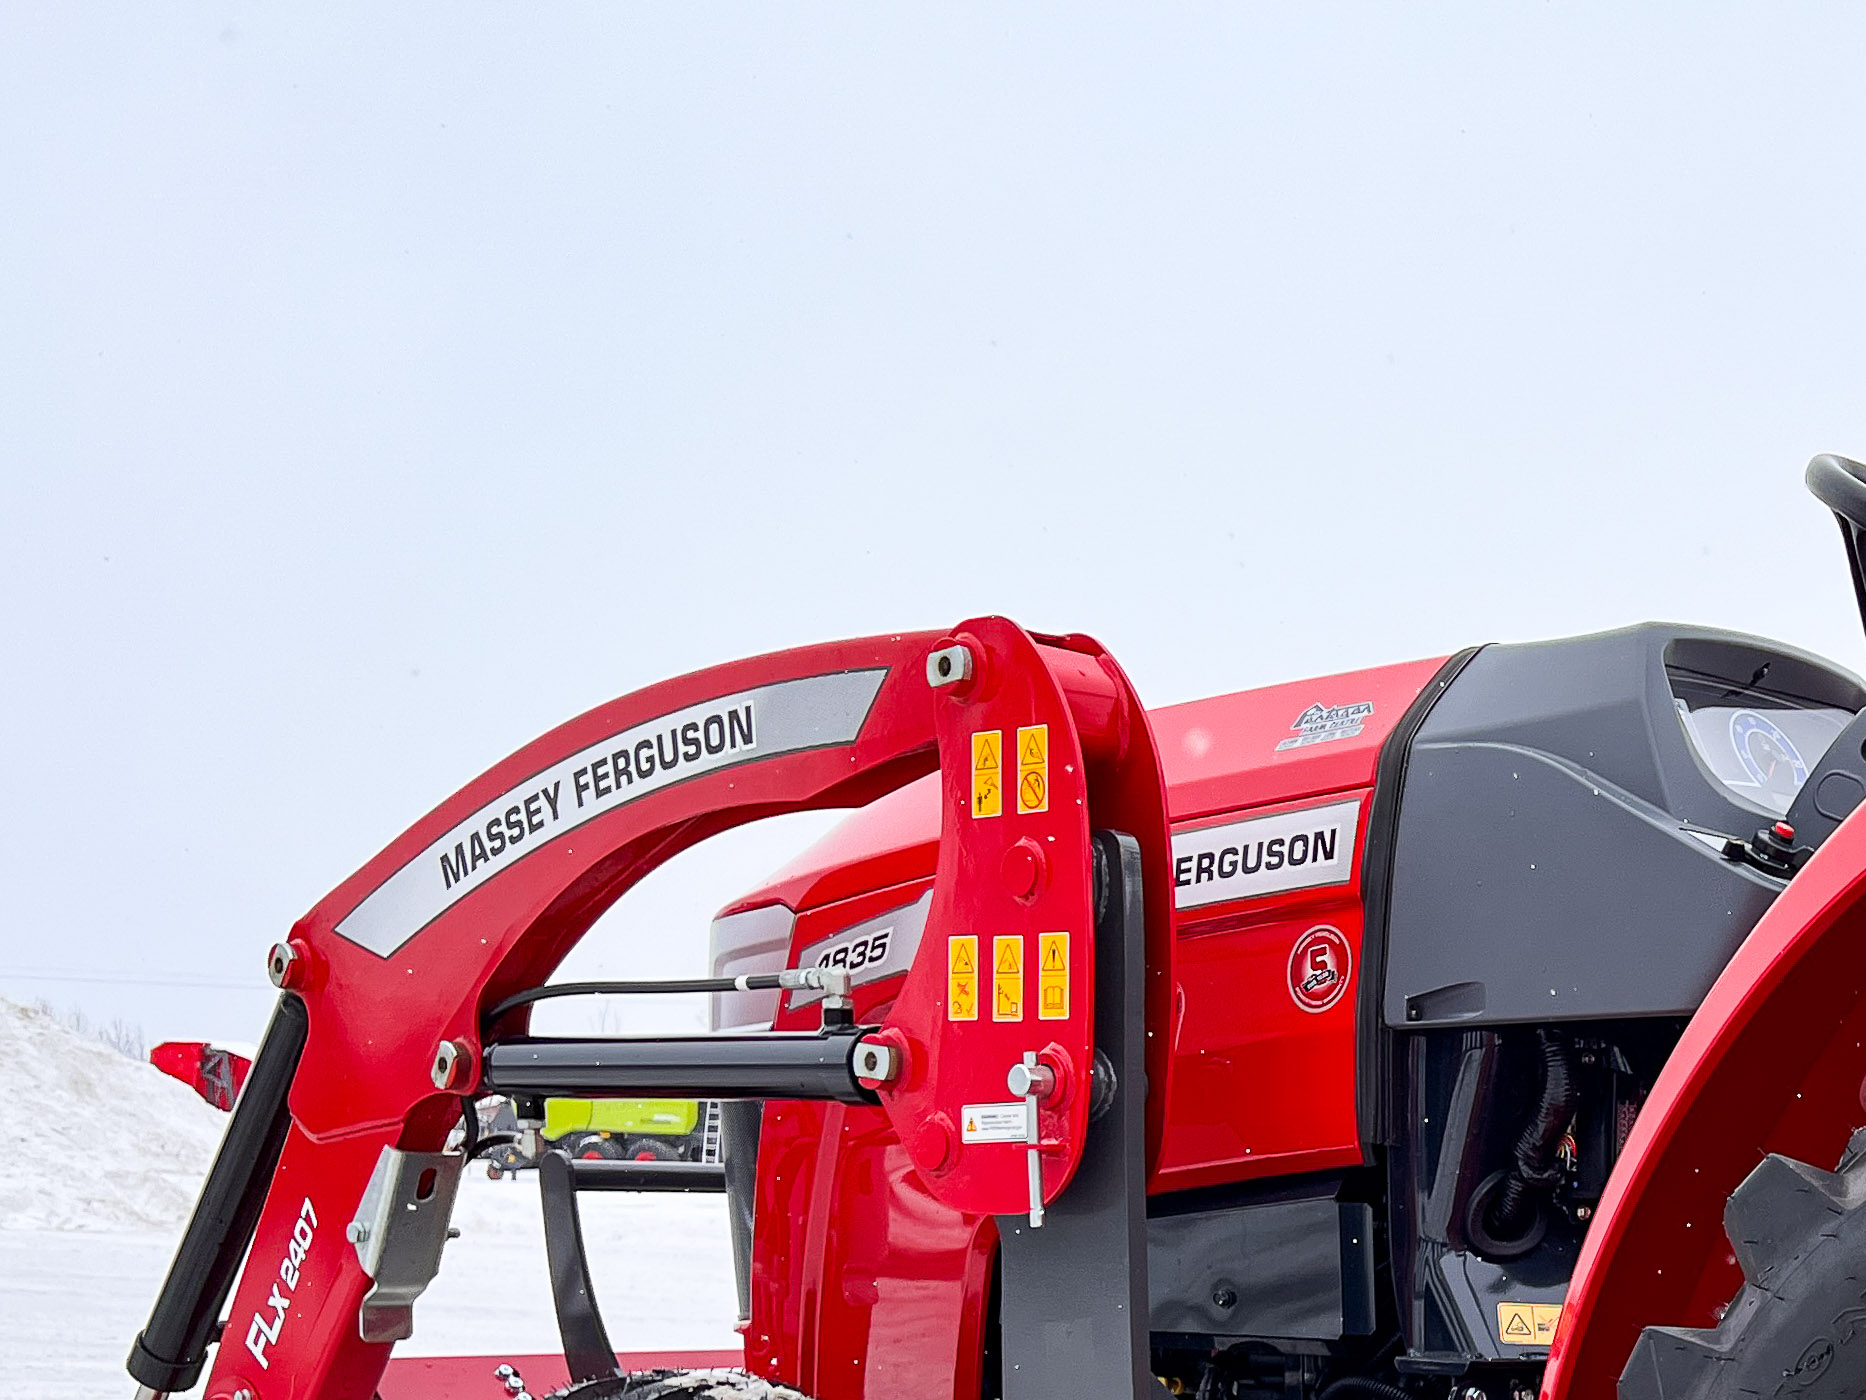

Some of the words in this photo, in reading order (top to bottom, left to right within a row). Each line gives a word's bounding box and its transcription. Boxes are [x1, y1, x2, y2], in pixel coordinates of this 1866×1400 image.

[439, 780, 561, 891] MASSEY
[573, 704, 754, 809] FERGUSON
[1175, 828, 1337, 887] ERGUSON
[280, 1196, 318, 1292] 2407
